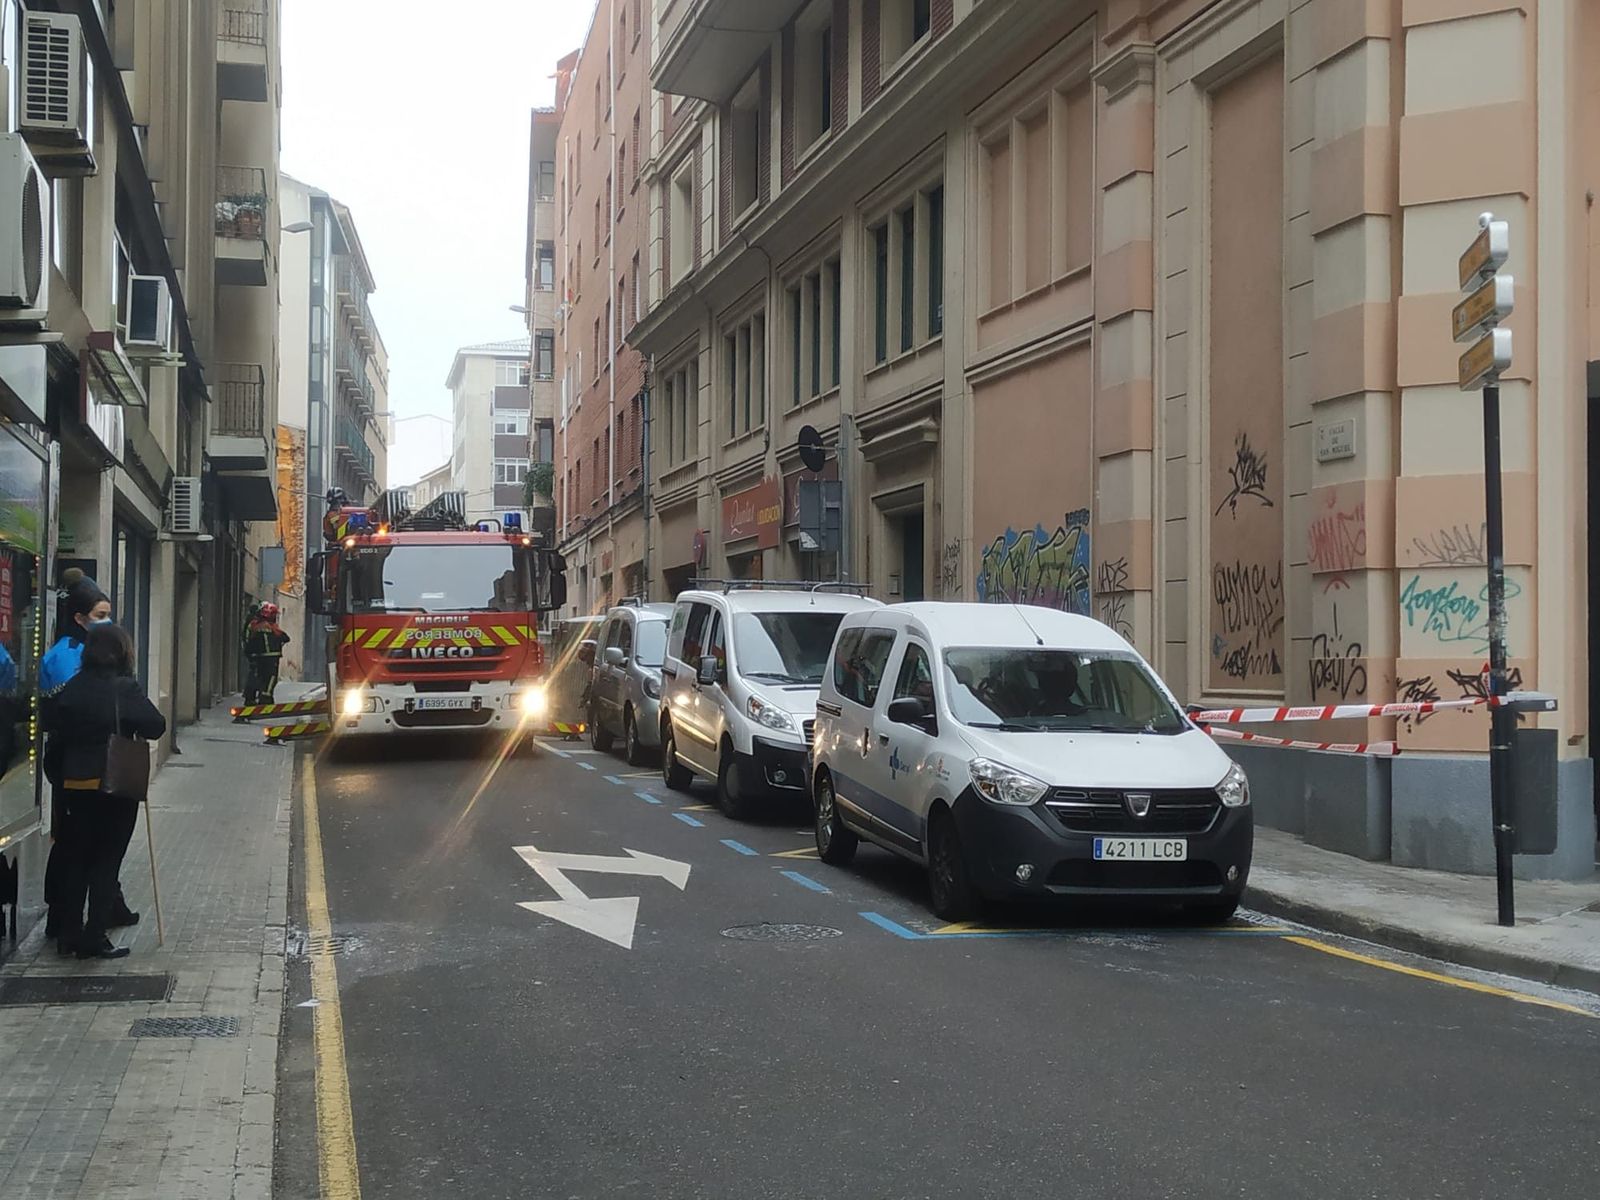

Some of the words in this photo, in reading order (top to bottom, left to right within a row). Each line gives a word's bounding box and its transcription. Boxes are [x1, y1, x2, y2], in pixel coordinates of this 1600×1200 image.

[414, 615, 470, 624] MAGIRUS
[411, 646, 474, 659] IVECO
[425, 699, 446, 708] 6395
[448, 699, 464, 708] GYX
[1106, 841, 1145, 858] 4211
[1153, 841, 1183, 858] LCB
